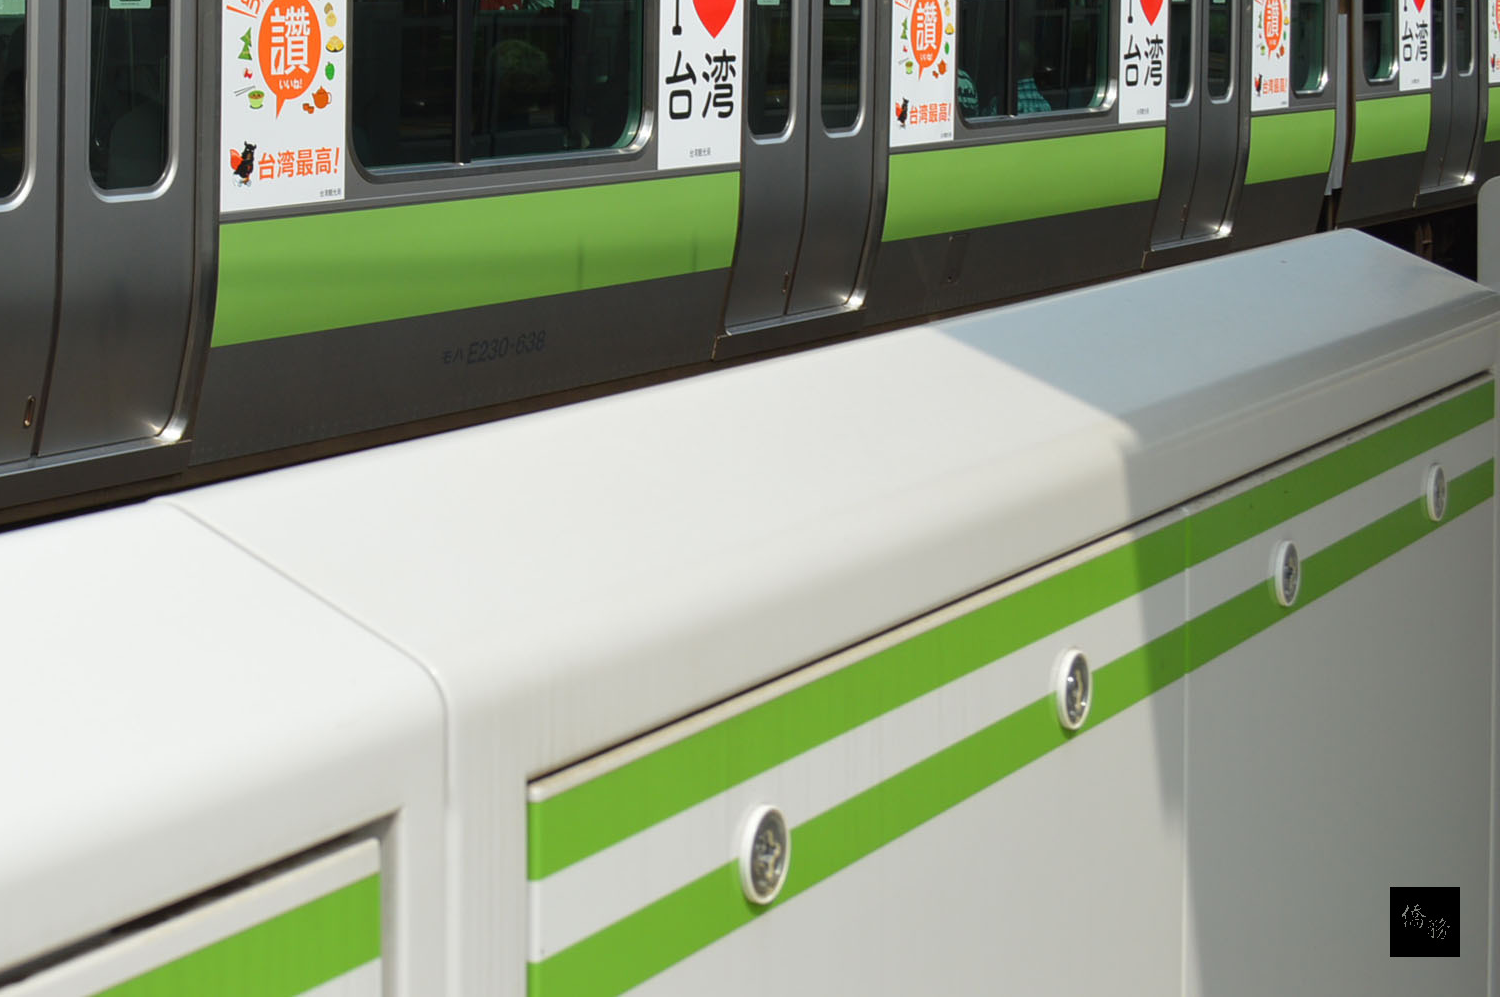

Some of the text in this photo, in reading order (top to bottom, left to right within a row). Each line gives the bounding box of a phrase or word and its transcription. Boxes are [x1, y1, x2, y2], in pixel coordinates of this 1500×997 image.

[665, 48, 737, 120] 台湾
[1123, 34, 1164, 87] 台湾
[258, 146, 340, 181] 台湾最高!
